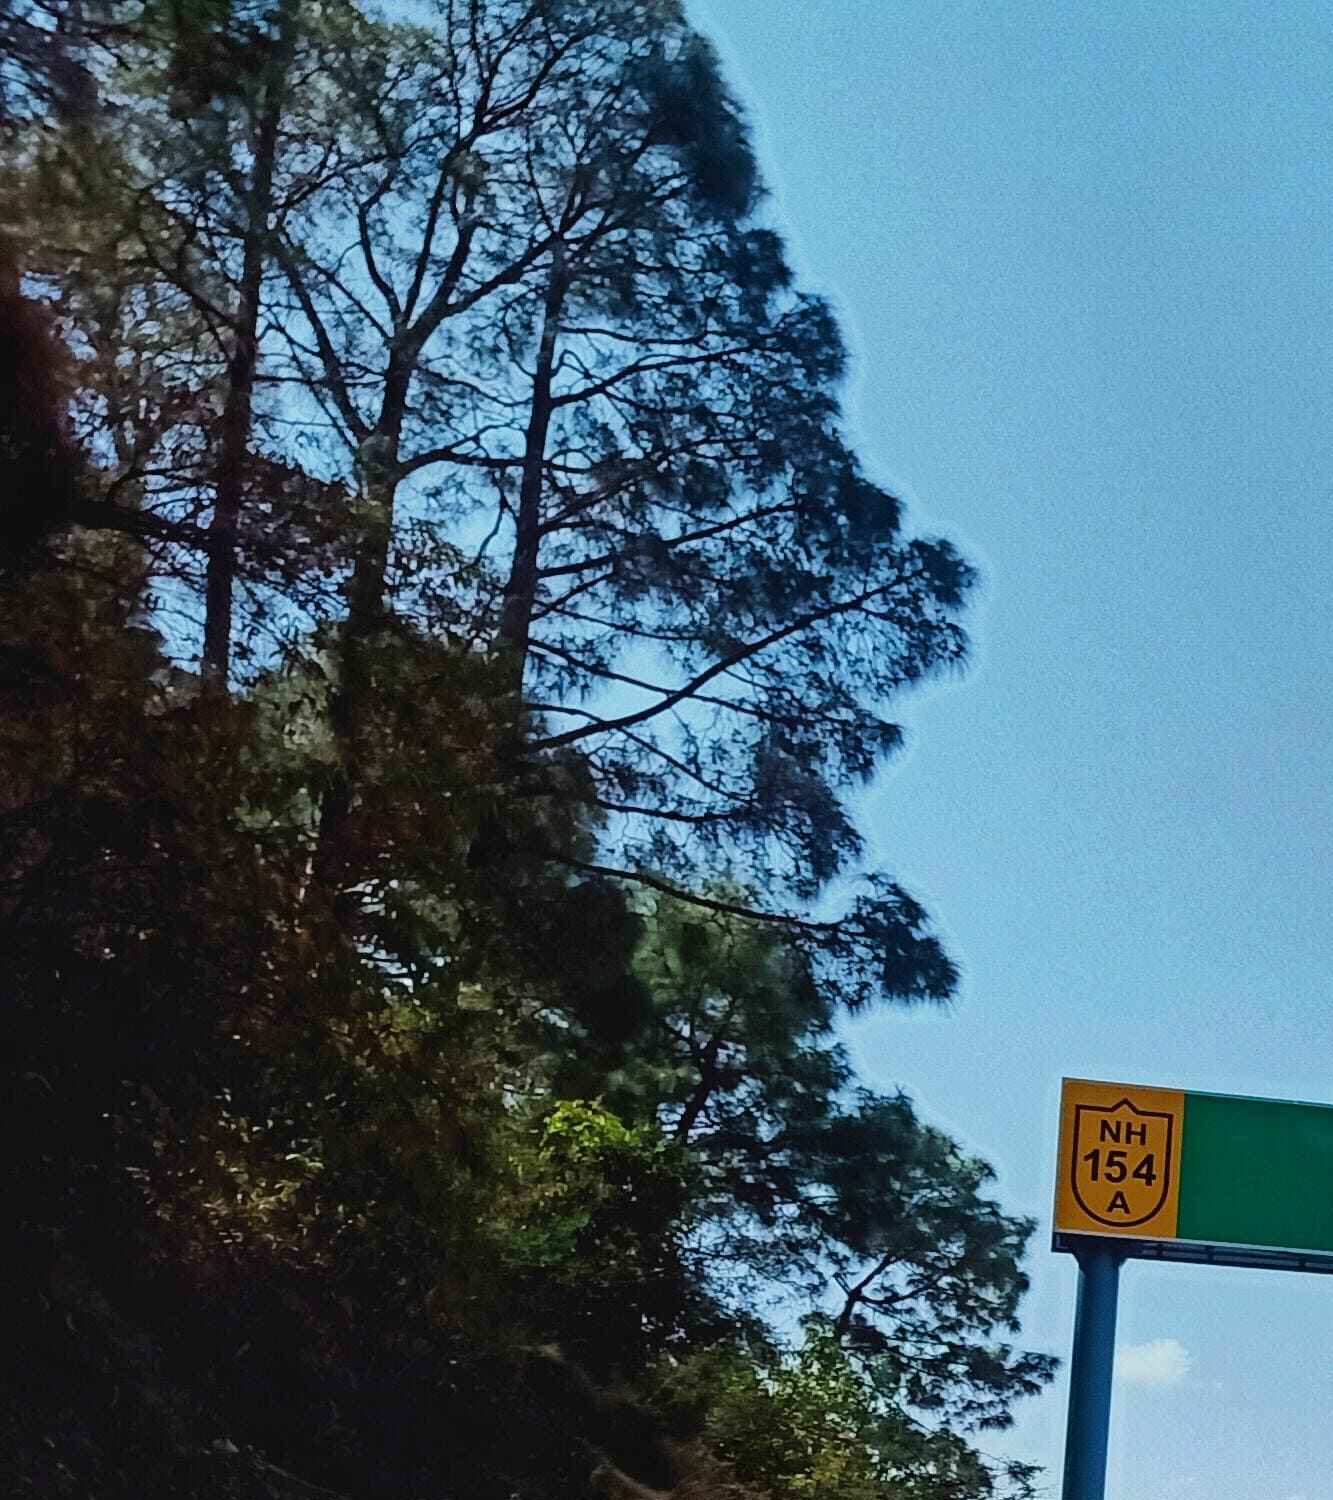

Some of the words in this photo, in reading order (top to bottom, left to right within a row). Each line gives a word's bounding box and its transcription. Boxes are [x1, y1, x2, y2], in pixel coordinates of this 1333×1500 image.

[1100, 1119, 1147, 1146] NH
[1083, 1148, 1157, 1187] 154
[1106, 1190, 1131, 1215] A
